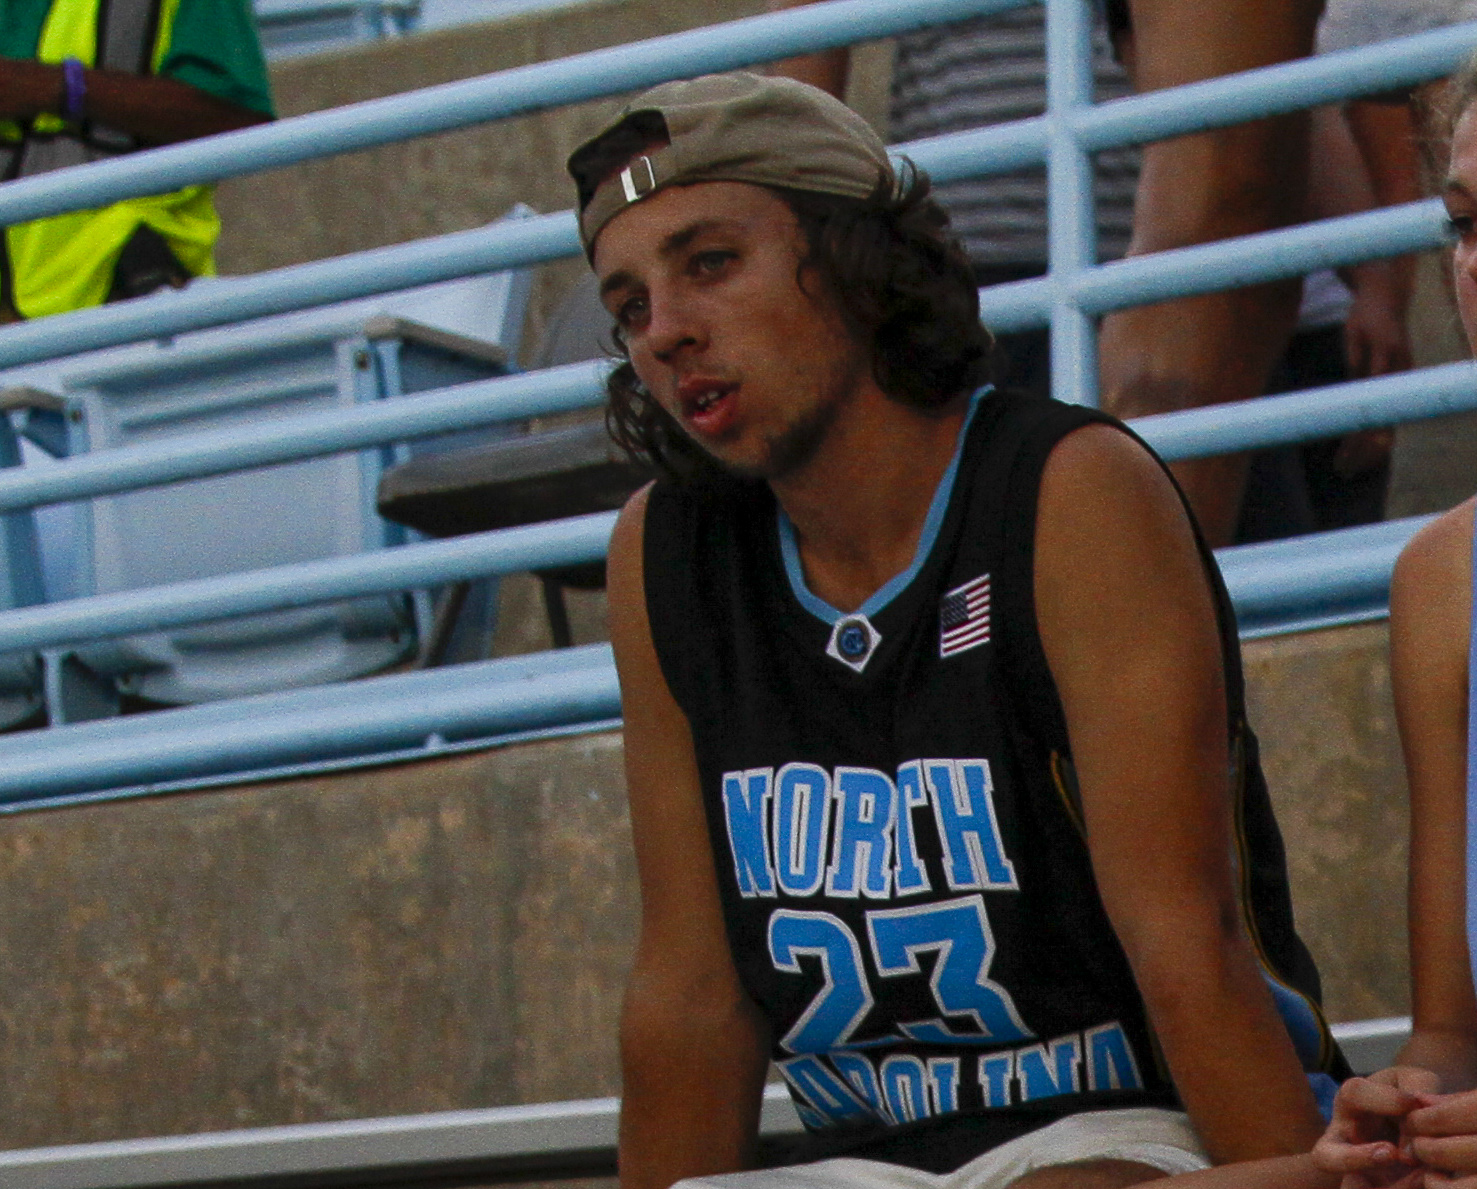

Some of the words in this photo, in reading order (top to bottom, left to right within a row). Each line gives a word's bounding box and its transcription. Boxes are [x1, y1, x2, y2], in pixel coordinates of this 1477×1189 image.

[722, 758, 1020, 899] NORTH
[767, 894, 1038, 1055] 23
[772, 1021, 1145, 1130] AROLINA
